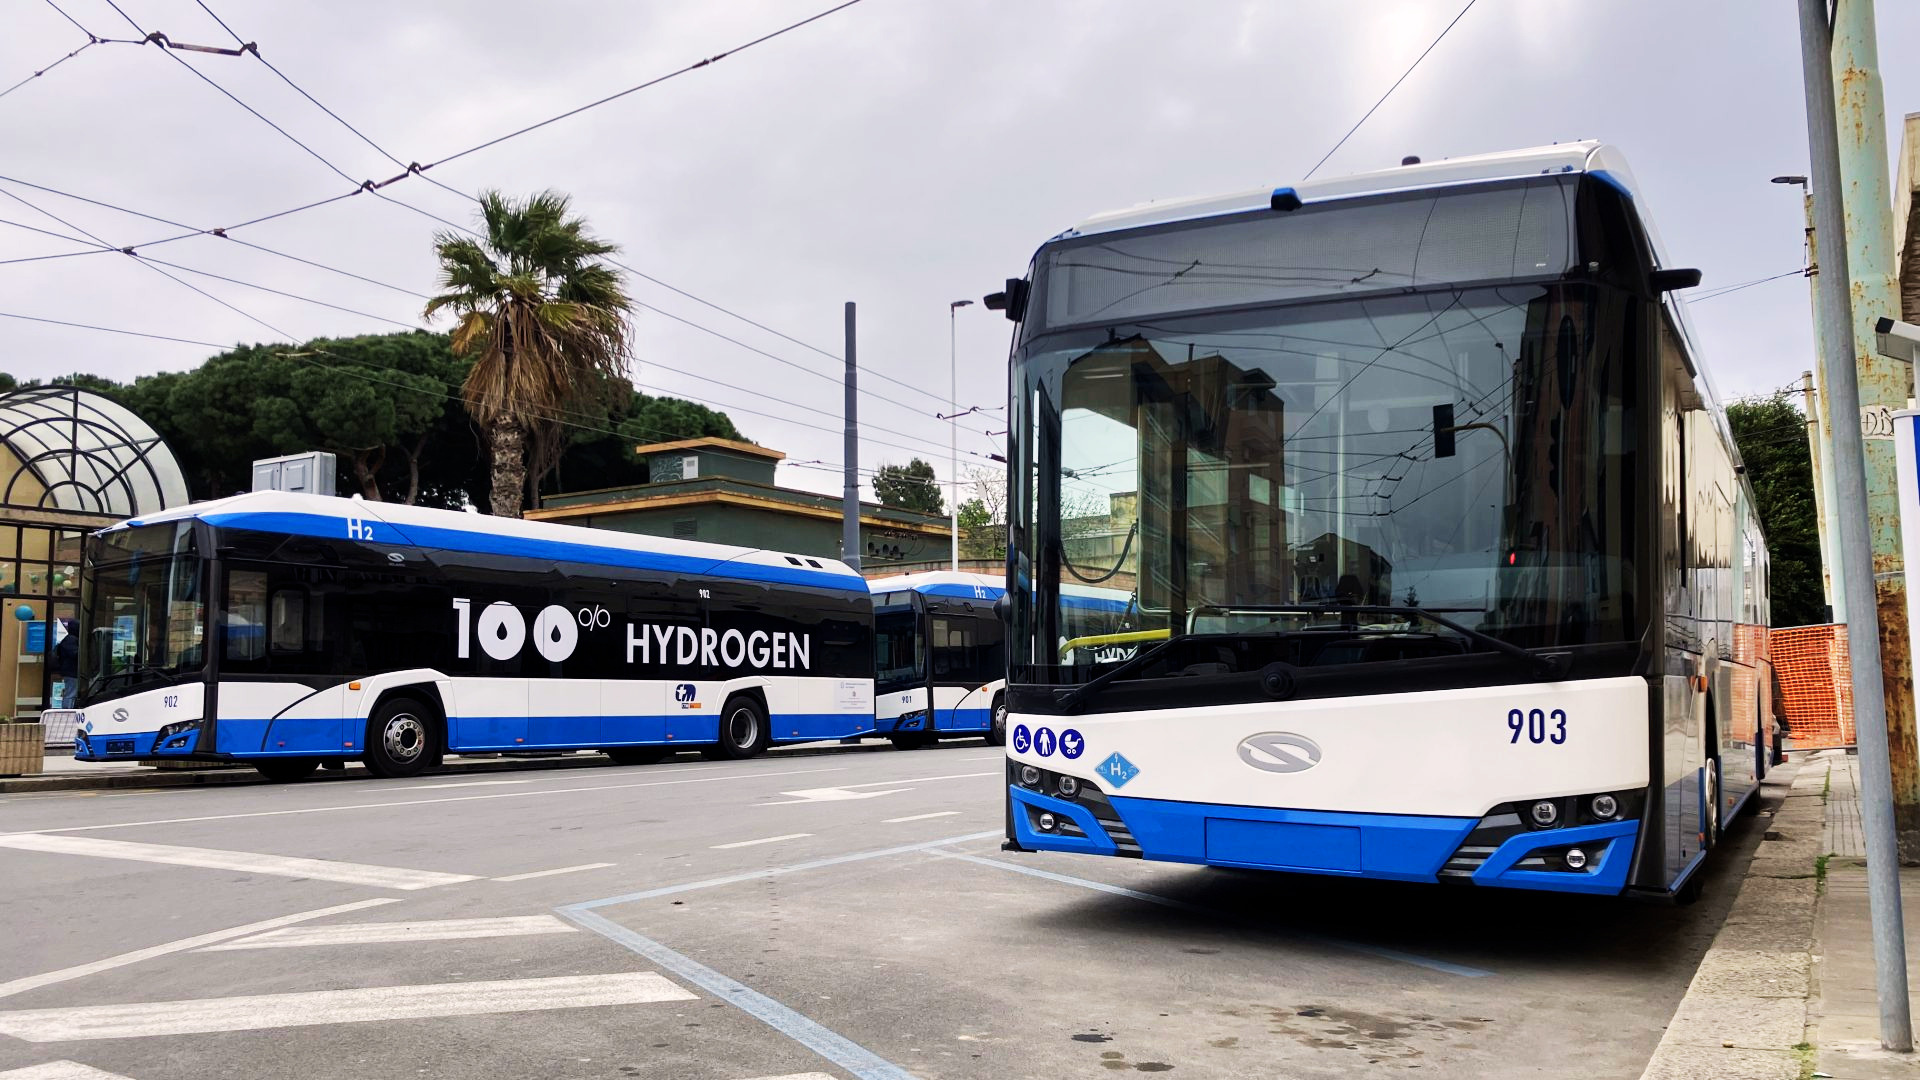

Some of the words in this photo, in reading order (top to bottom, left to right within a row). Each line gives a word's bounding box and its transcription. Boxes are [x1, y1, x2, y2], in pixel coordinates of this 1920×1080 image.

[347, 517, 374, 541] H2
[974, 585, 987, 599] H2
[626, 622, 811, 670] HYDROGEN
[164, 695, 178, 708] 902
[1506, 708, 1567, 745] 903
[1110, 762, 1128, 780] H2
